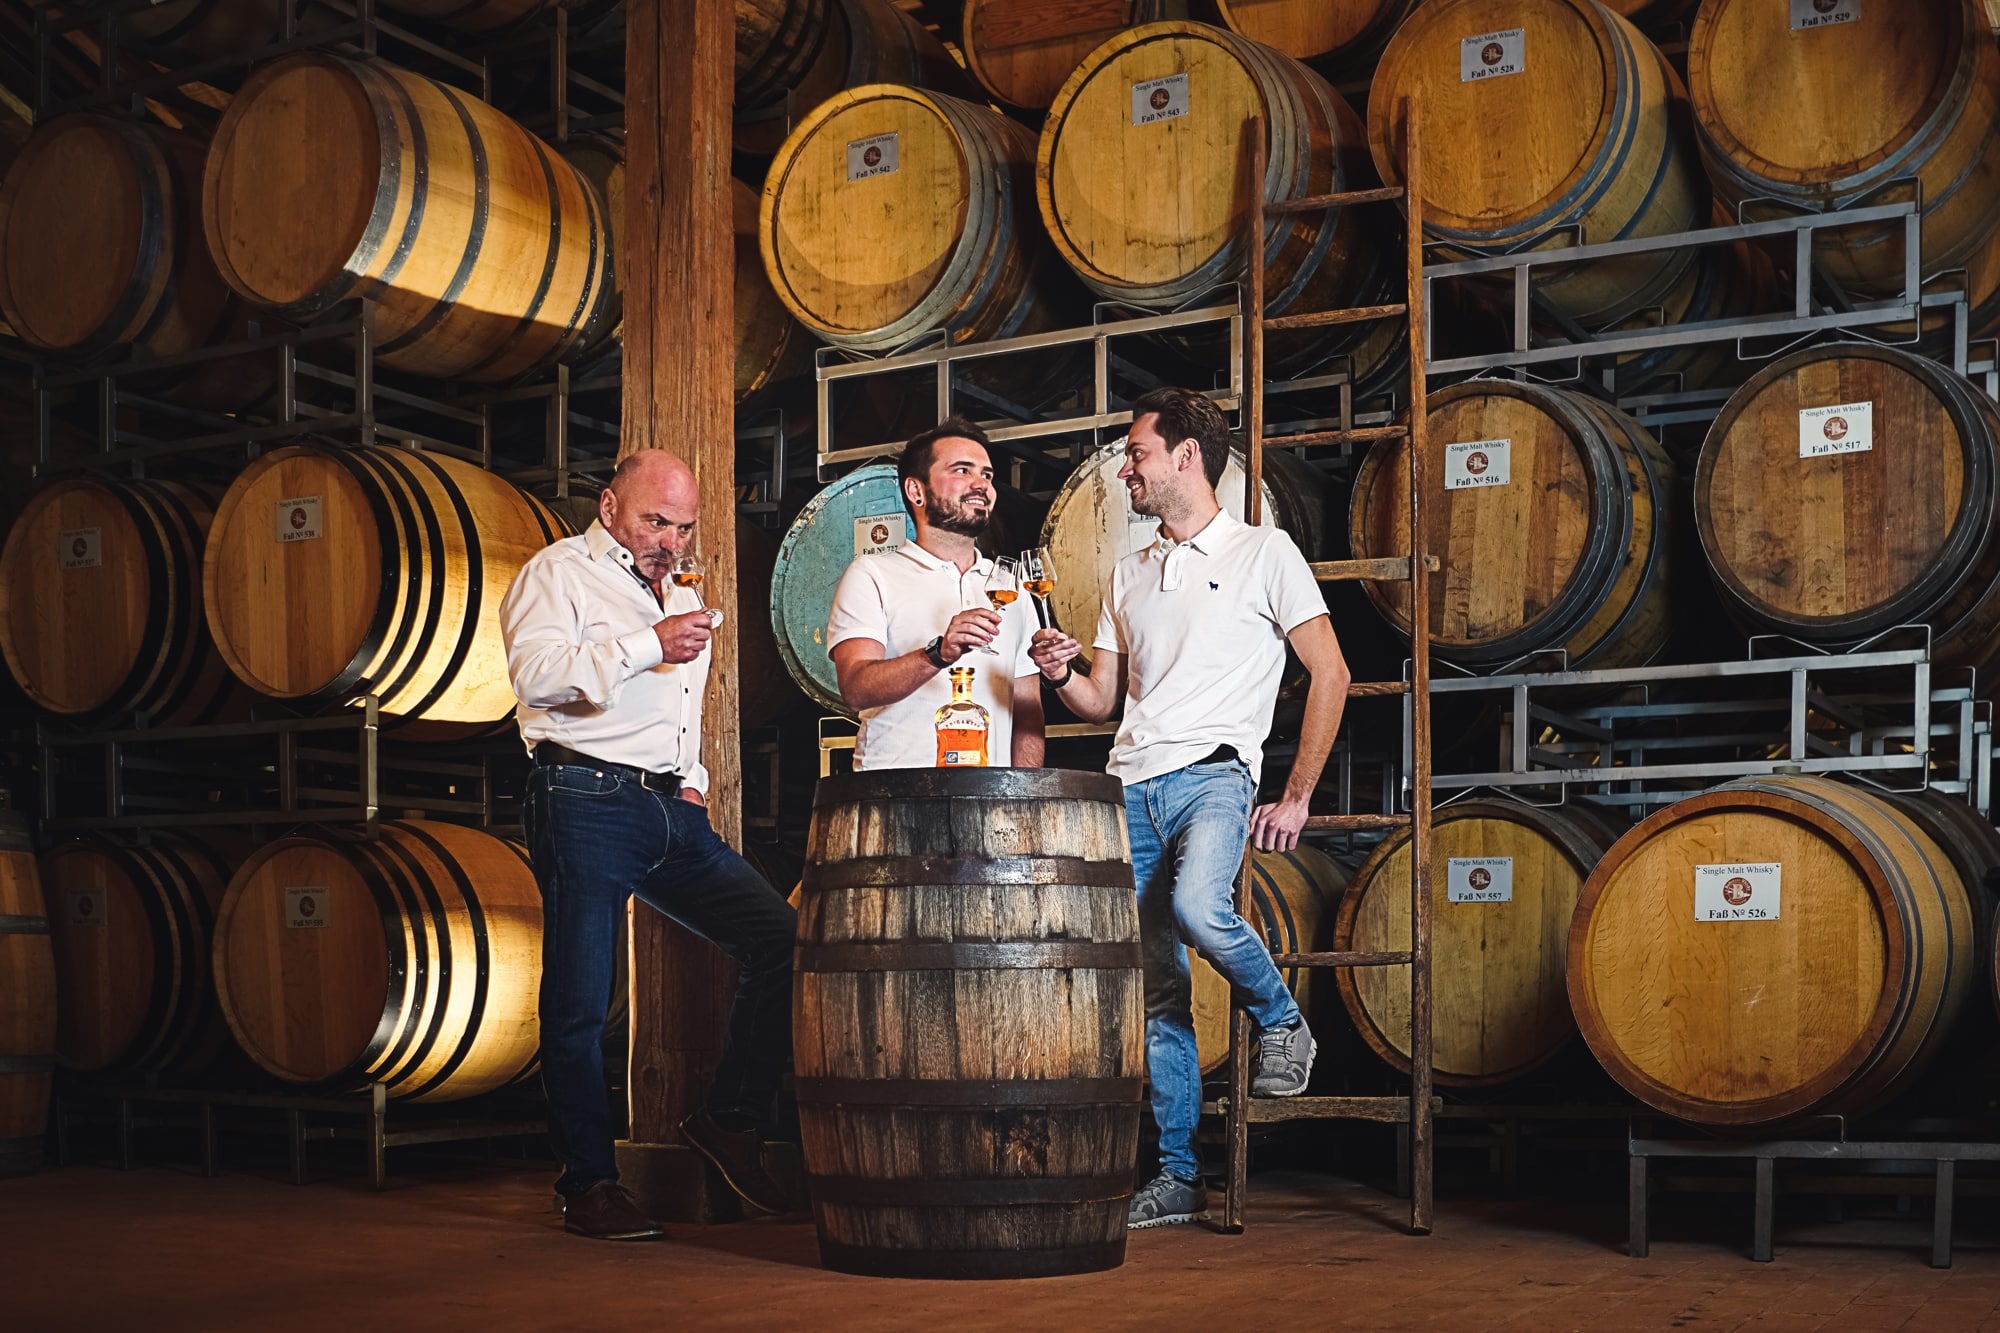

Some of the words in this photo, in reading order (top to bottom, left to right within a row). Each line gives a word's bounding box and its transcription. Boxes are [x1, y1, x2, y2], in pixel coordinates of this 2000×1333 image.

[1834, 11, 1850, 22] 529
[1500, 64, 1515, 74] 528
[1167, 108, 1180, 117] 543
[879, 165, 890, 174] 542
[1826, 407, 1841, 415] Malt
[1842, 405, 1866, 413] Whisky
[1483, 441, 1505, 449] Whisky
[1845, 440, 1861, 451] 517
[1485, 475, 1500, 484] 516
[957, 729, 968, 737] 12
[1702, 867, 1726, 877] Single
[1727, 867, 1745, 875] Malt
[1746, 865, 1774, 875] Whisky
[1487, 892, 1502, 901] 557
[1748, 908, 1767, 919] 526
